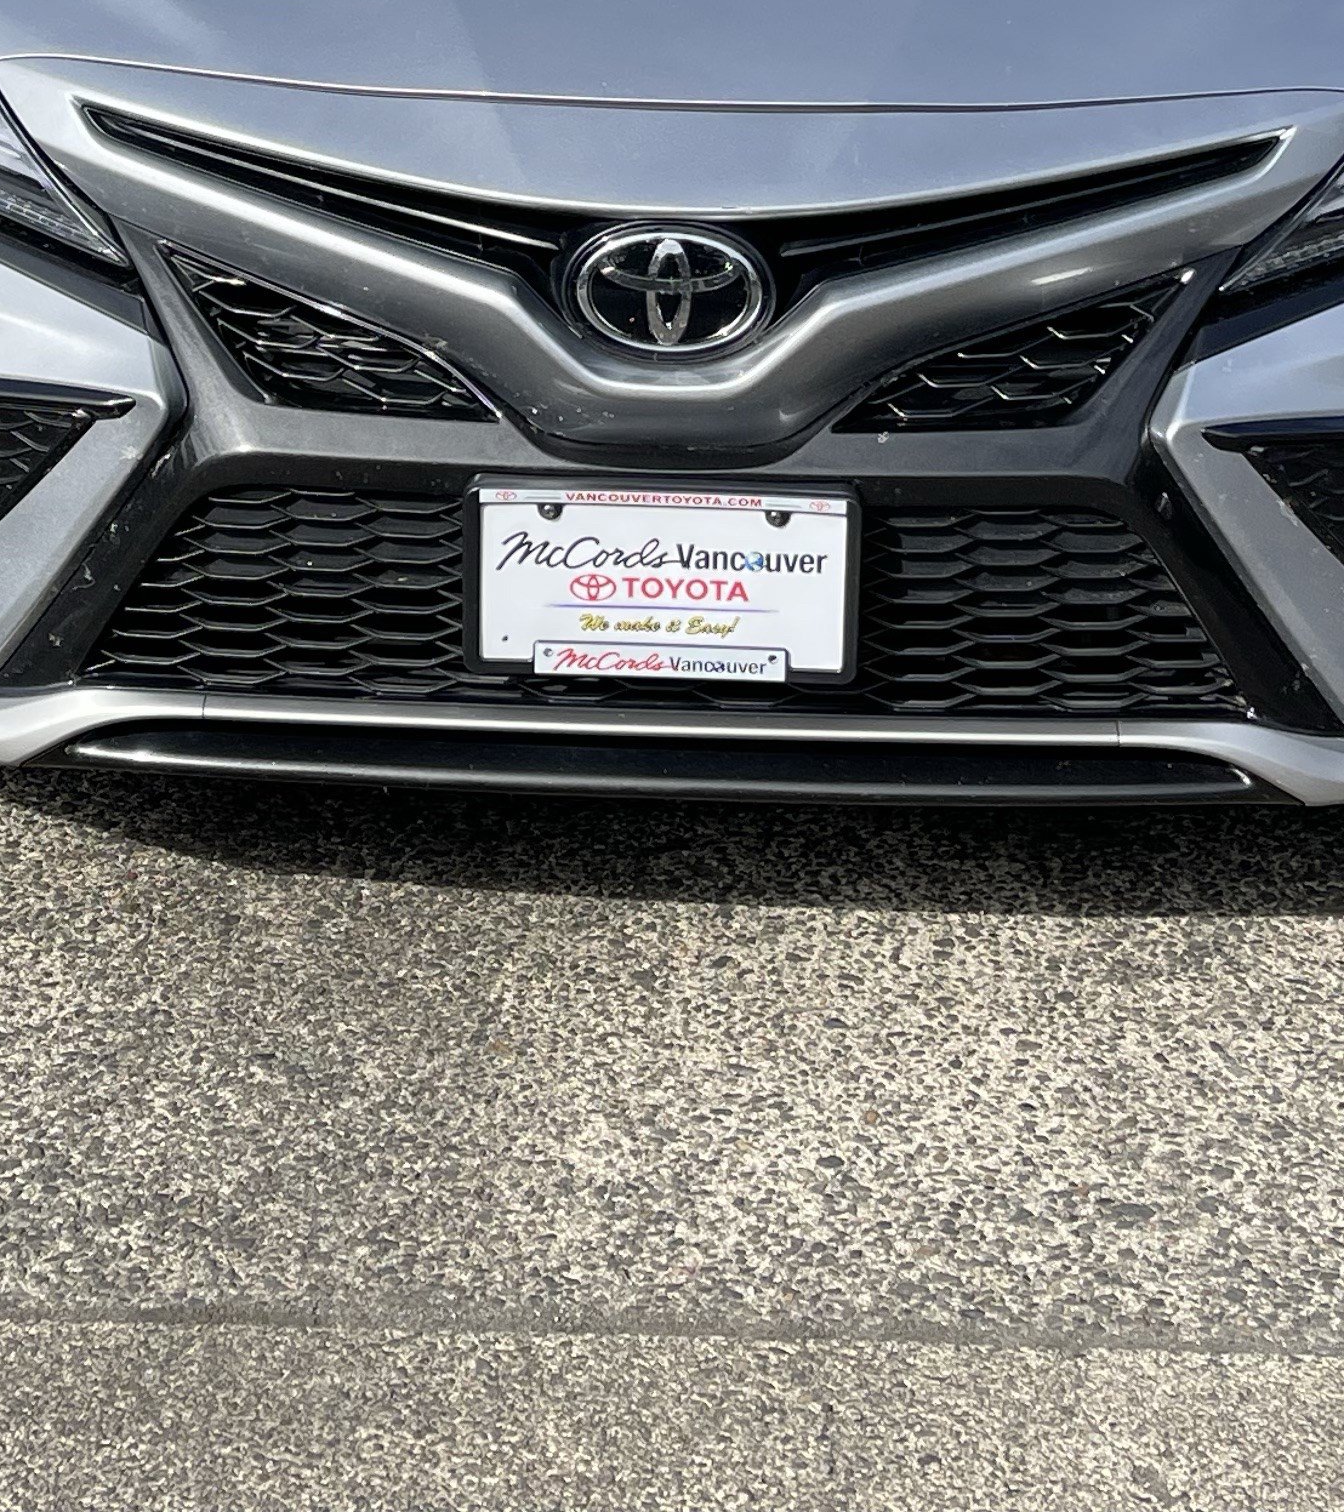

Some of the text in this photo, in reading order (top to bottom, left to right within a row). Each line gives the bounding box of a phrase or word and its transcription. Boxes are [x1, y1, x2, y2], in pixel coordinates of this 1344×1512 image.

[564, 491, 763, 507] VANCOUVERTOYOTA.COM
[495, 531, 828, 574] McCords Vancouver
[622, 577, 749, 602] TOYOTA
[580, 613, 609, 631] We
[614, 616, 661, 633] make
[685, 615, 741, 638] Easy!
[553, 648, 767, 675] McCords Vancouver
